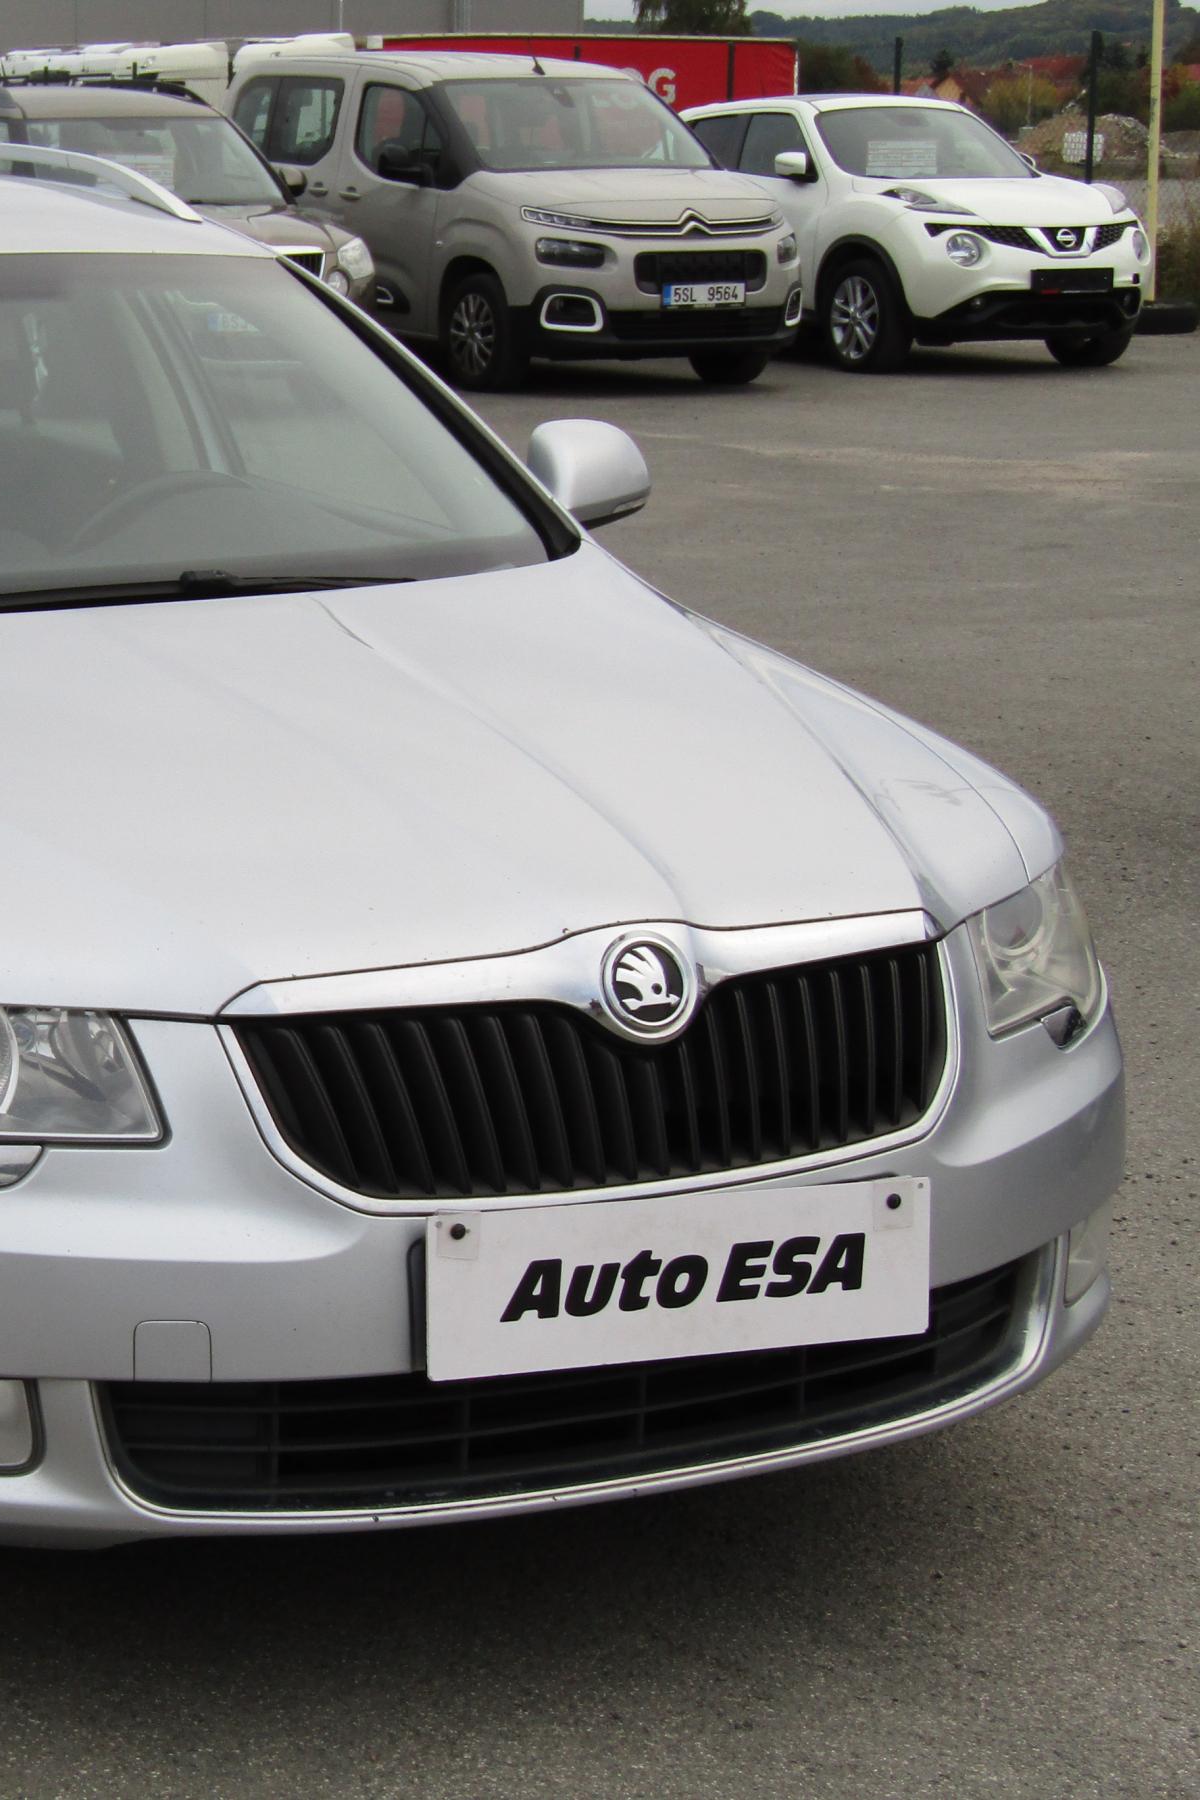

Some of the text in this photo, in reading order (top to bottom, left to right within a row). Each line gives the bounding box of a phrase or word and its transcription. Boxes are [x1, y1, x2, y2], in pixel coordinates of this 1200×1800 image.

[673, 285, 739, 303] 5SL 9564
[499, 1232, 866, 1323] Auto ESA
